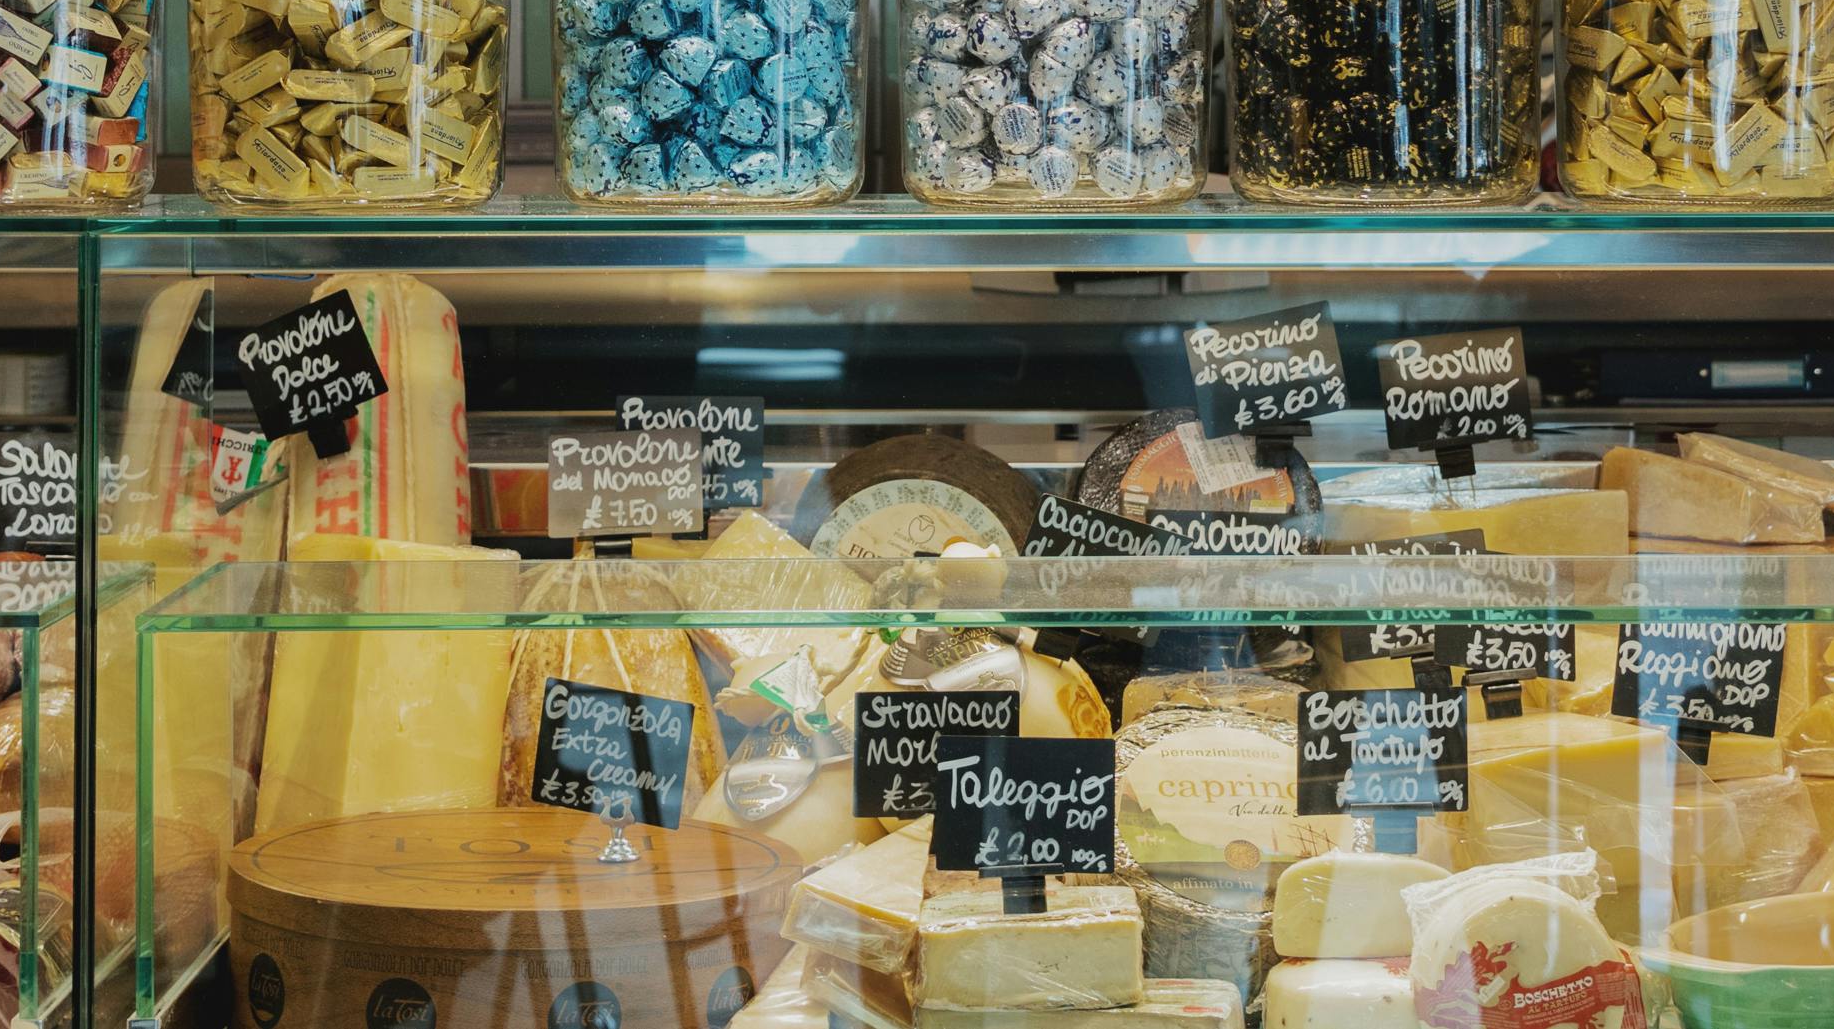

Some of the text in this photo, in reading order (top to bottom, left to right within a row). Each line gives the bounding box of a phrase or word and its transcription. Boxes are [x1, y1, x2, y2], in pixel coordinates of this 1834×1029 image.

[240, 307, 356, 371] Provolone
[1191, 311, 1320, 361] Pecorino
[272, 356, 339, 400] Dolce
[1194, 348, 1337, 391] di Pienza
[1389, 337, 1514, 380] Pecorino
[622, 397, 759, 433] Provolone
[1387, 378, 1520, 419] Romano
[552, 435, 698, 472] Provolone
[552, 466, 698, 502] del Monaco DOP
[1619, 641, 1772, 686] Reggiano
[544, 678, 683, 745] Gorgonzola
[862, 695, 1013, 729] Stravacco
[1307, 689, 1463, 732] Boschetto
[1723, 684, 1769, 707] DOP
[552, 725, 627, 760] Extra
[1304, 734, 1445, 775] al Tartufo
[587, 755, 677, 800] Creamy
[938, 753, 1113, 821] Taleggio
[1066, 804, 1107, 830] DOP
[1513, 975, 1594, 1009] BOSCHETTO
